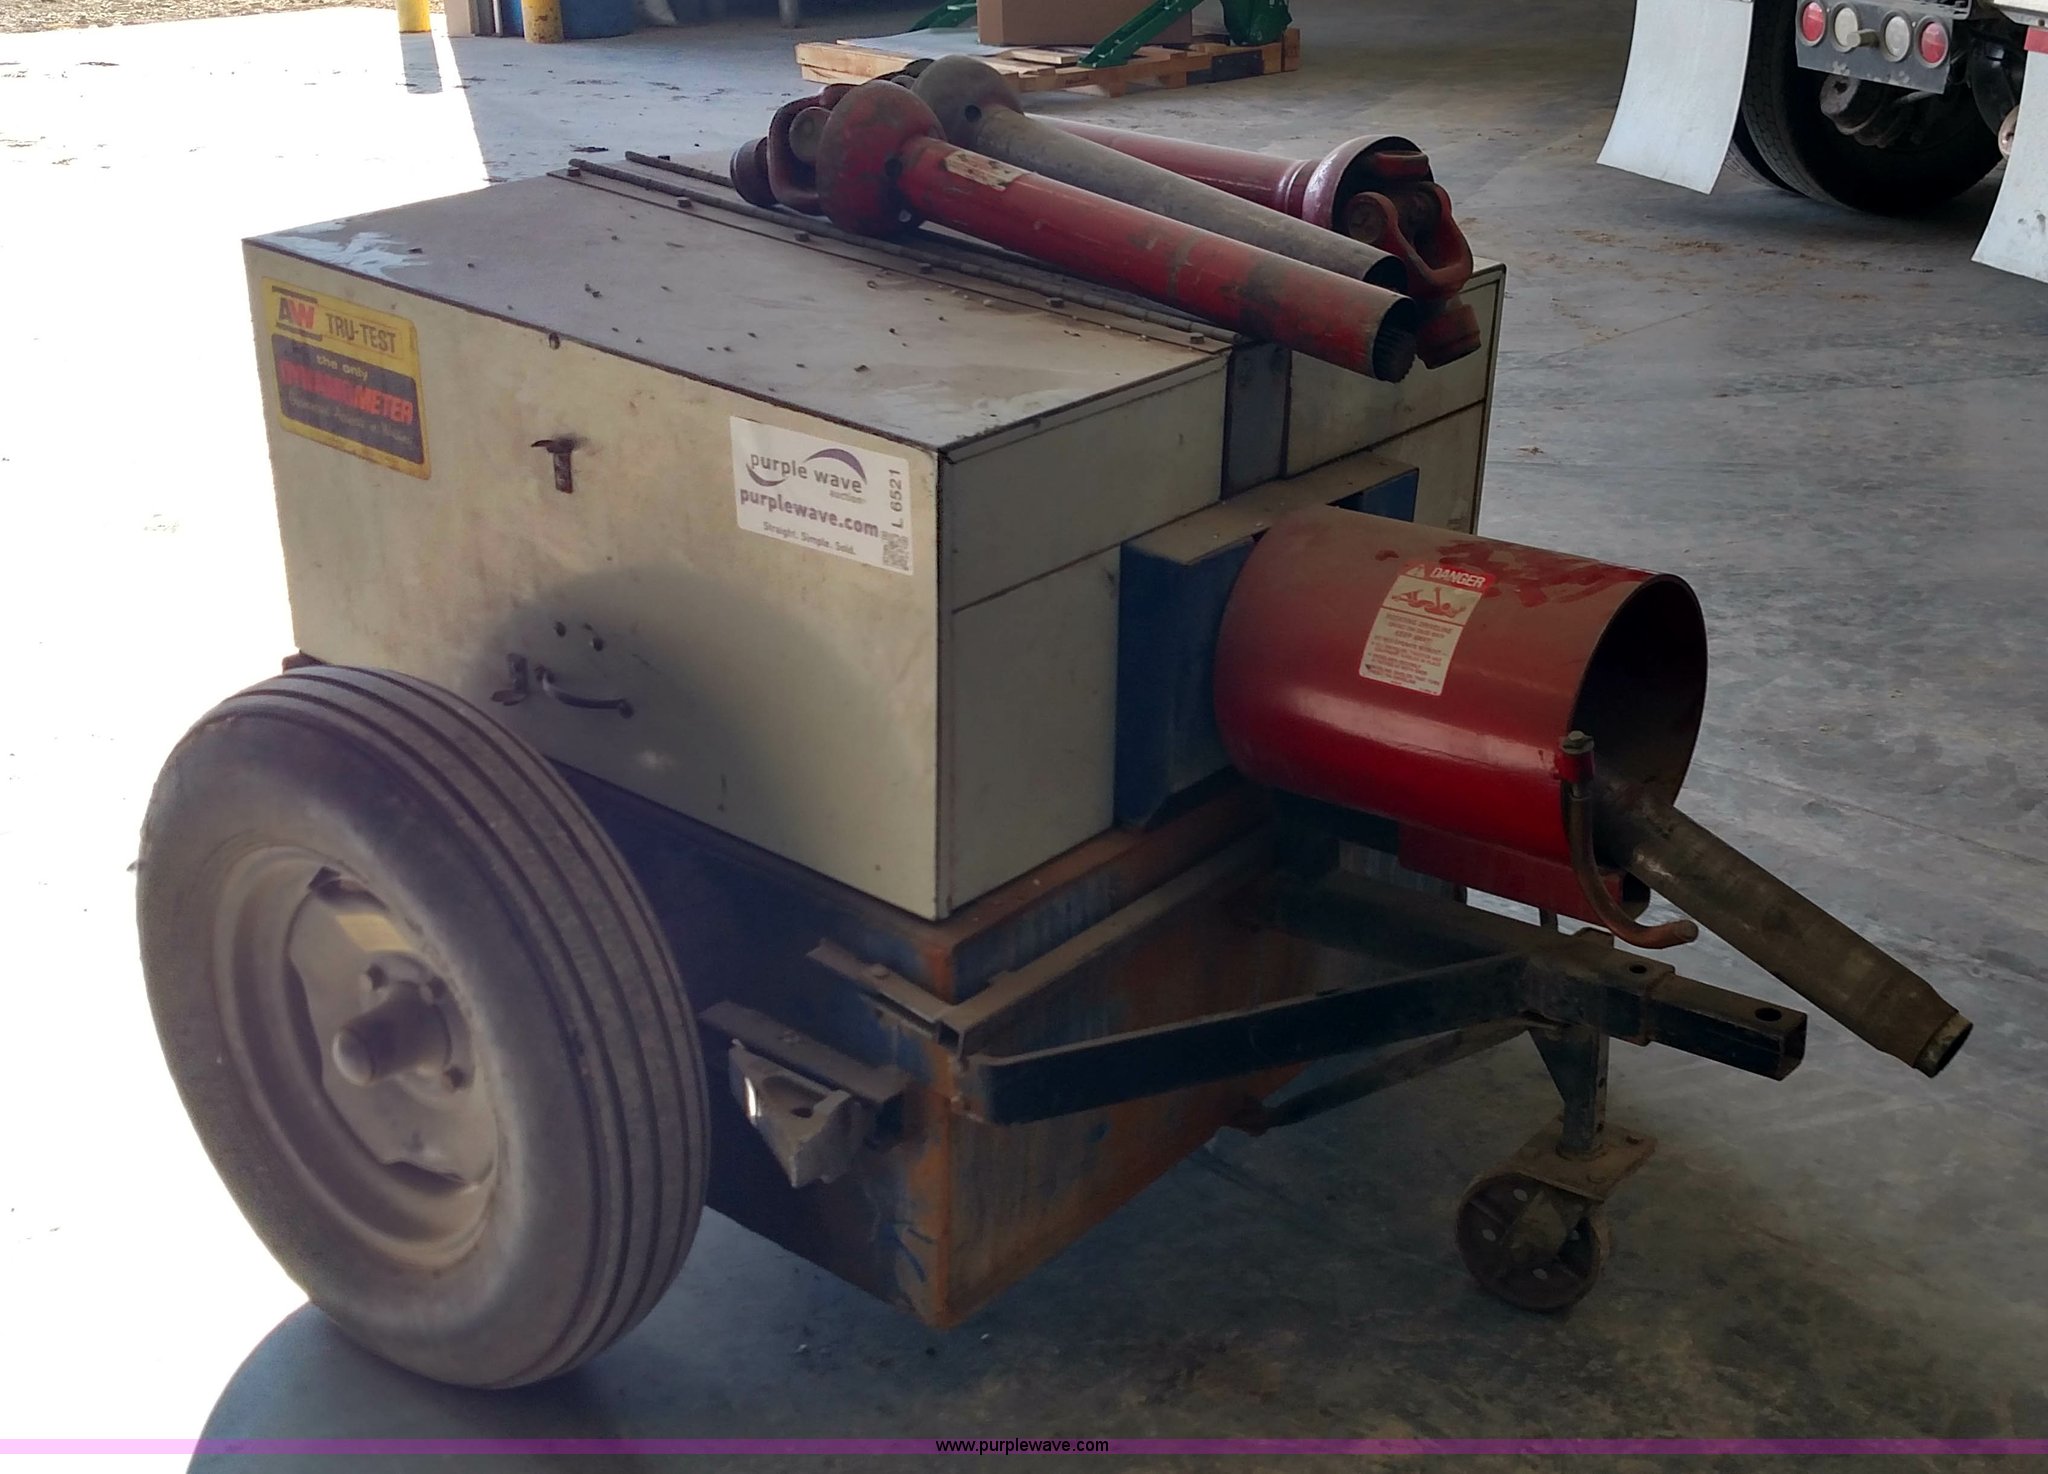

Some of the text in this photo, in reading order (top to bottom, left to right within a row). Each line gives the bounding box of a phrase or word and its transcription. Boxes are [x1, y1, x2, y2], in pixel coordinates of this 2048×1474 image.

[326, 312, 397, 353] TRU-TEST
[316, 355, 369, 381] the only
[750, 453, 862, 494] purple wave
[740, 487, 879, 539] purplewave.com
[1430, 567, 1487, 589] DANGER
